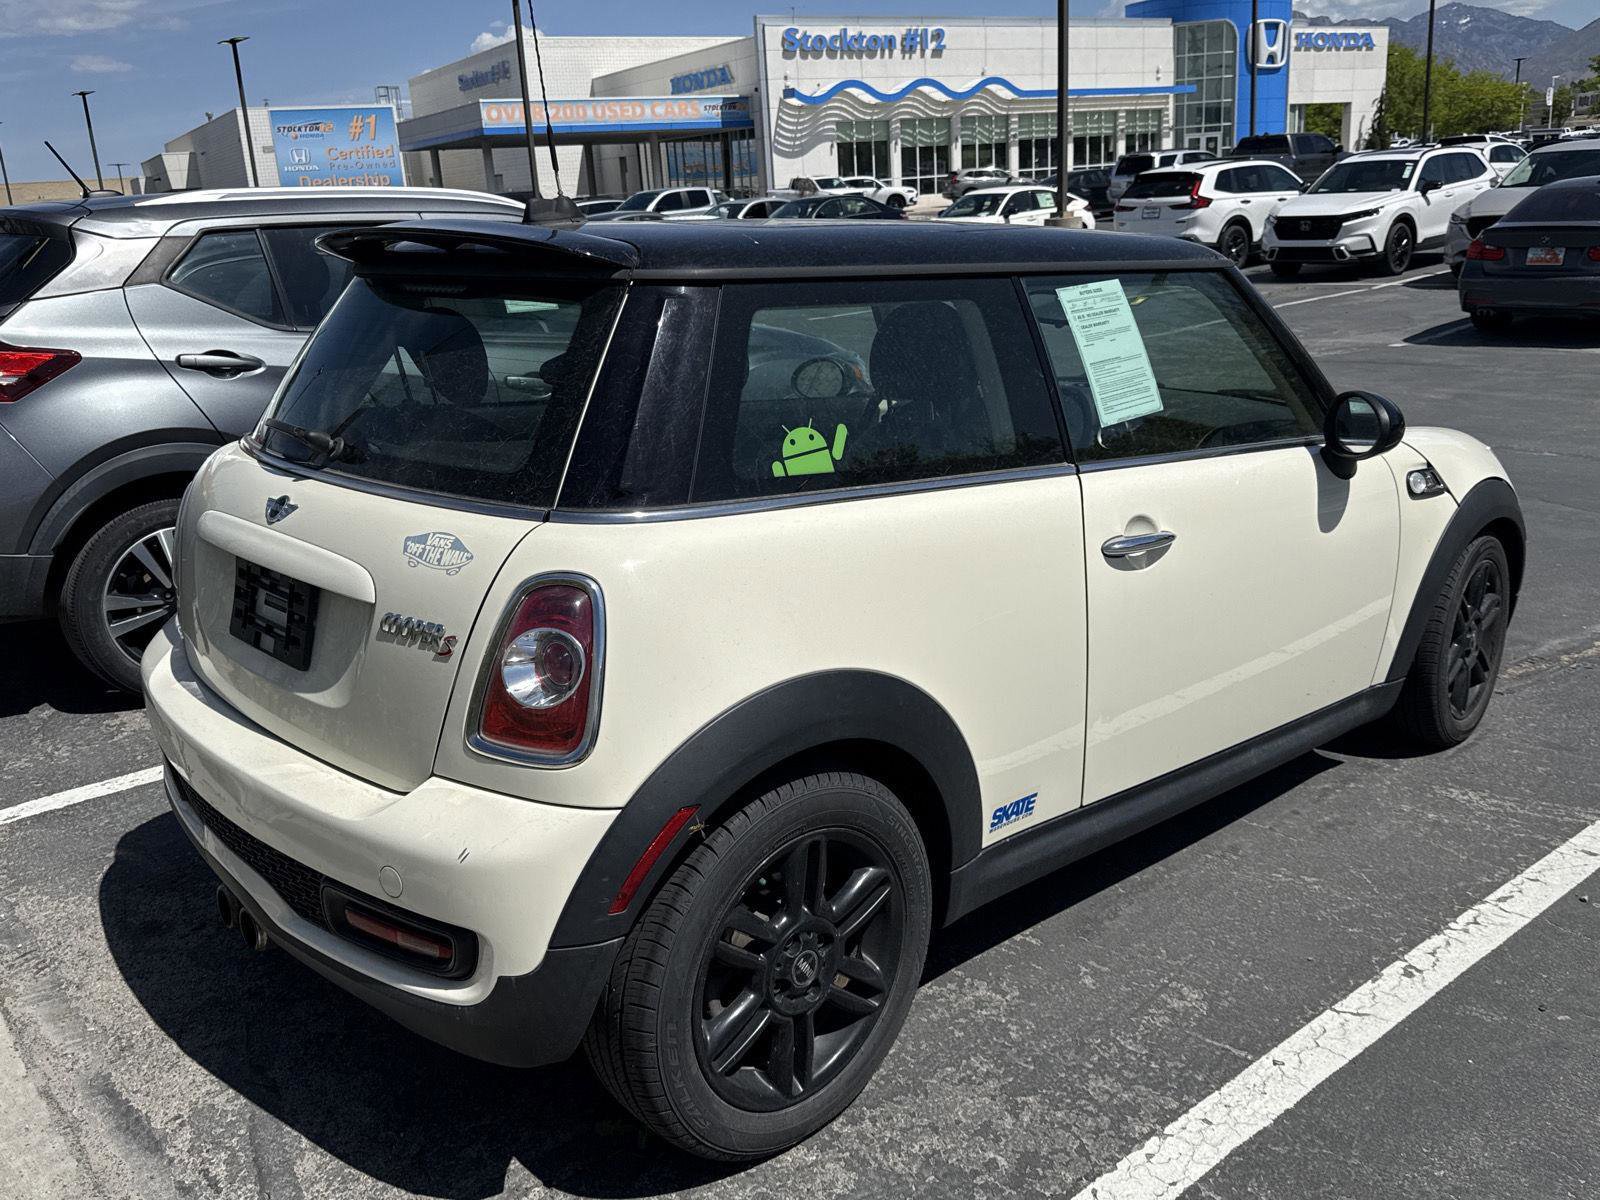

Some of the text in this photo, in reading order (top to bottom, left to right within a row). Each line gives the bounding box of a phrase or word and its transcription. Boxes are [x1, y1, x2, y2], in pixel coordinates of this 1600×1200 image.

[782, 27, 946, 54] Stockton #12
[1295, 32, 1376, 51] HONDA
[670, 66, 734, 95] HONDA
[550, 103, 587, 121] 200
[592, 102, 645, 121] USED
[651, 101, 699, 119] CARS
[276, 123, 320, 133] STOCKTON
[349, 114, 377, 140] #1
[326, 144, 394, 161] Certified
[329, 160, 396, 170] Pre-Owned
[300, 173, 391, 186] Dealership
[426, 532, 455, 549] VANS
[422, 545, 444, 565] THE
[380, 612, 457, 657] COOPER S
[990, 792, 1038, 828] SKATE
[797, 957, 814, 979] MINI
